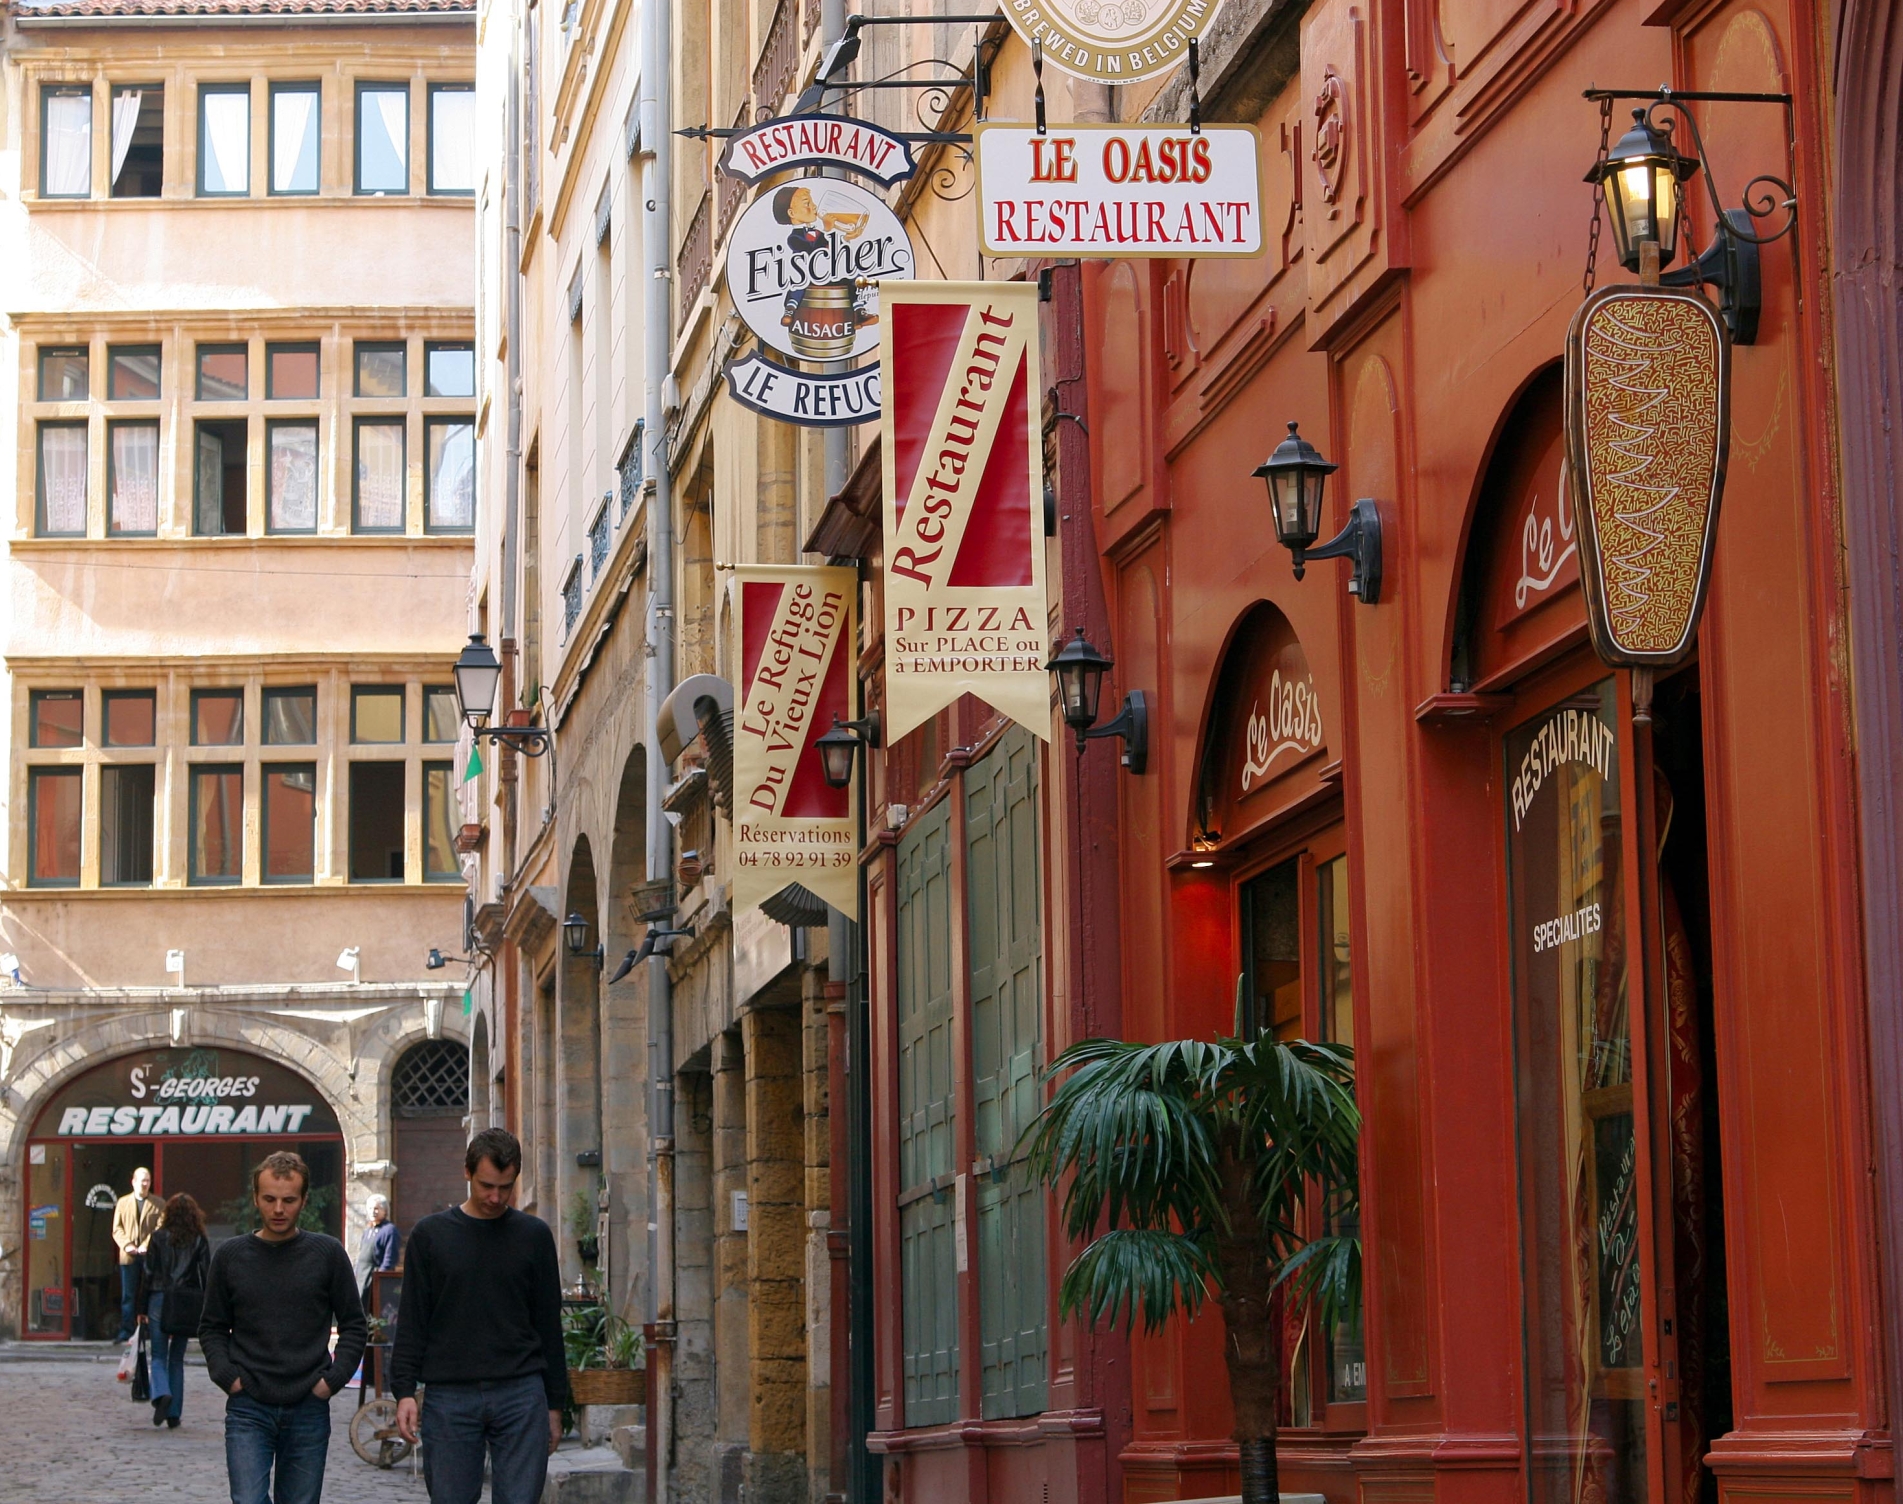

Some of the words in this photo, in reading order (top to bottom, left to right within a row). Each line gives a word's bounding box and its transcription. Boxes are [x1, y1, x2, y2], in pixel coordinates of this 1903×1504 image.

[1012, 0, 1089, 67] BREWED
[1095, 54, 1121, 73] IN
[1128, 0, 1208, 71] BELGIUM
[741, 122, 897, 170] RESTAURANT
[1028, 136, 1079, 184] LE
[1102, 135, 1213, 185] OASIS
[993, 200, 1250, 243] RESTAURANT
[745, 231, 898, 298] Fischer
[791, 319, 853, 338] ALSACE
[742, 365, 779, 404] LE
[890, 304, 1014, 592] Restaurant
[1515, 494, 1554, 610] Le
[757, 583, 815, 693] Refuge
[798, 590, 843, 664] Lion
[894, 606, 1035, 632] PIZZA
[895, 637, 928, 653] Sur
[935, 636, 1009, 653] PLACE
[1015, 640, 1040, 651] ou
[895, 657, 905, 673] à
[912, 656, 1043, 673] EMPORTER
[741, 699, 775, 741] Le
[766, 667, 817, 753] Vieux
[1242, 700, 1268, 791] Le
[1269, 669, 1322, 747] Oasis
[749, 765, 787, 816] Du
[1511, 709, 1614, 832] RESTAURANT
[739, 823, 851, 843] Réservations
[739, 850, 758, 867] 04
[762, 851, 781, 867] 78
[785, 851, 804, 867] 92
[809, 852, 826, 868] 91
[832, 852, 851, 867] 39
[1533, 903, 1601, 953] SPECIALITES
[57, 1105, 312, 1136] RESTAURANT
